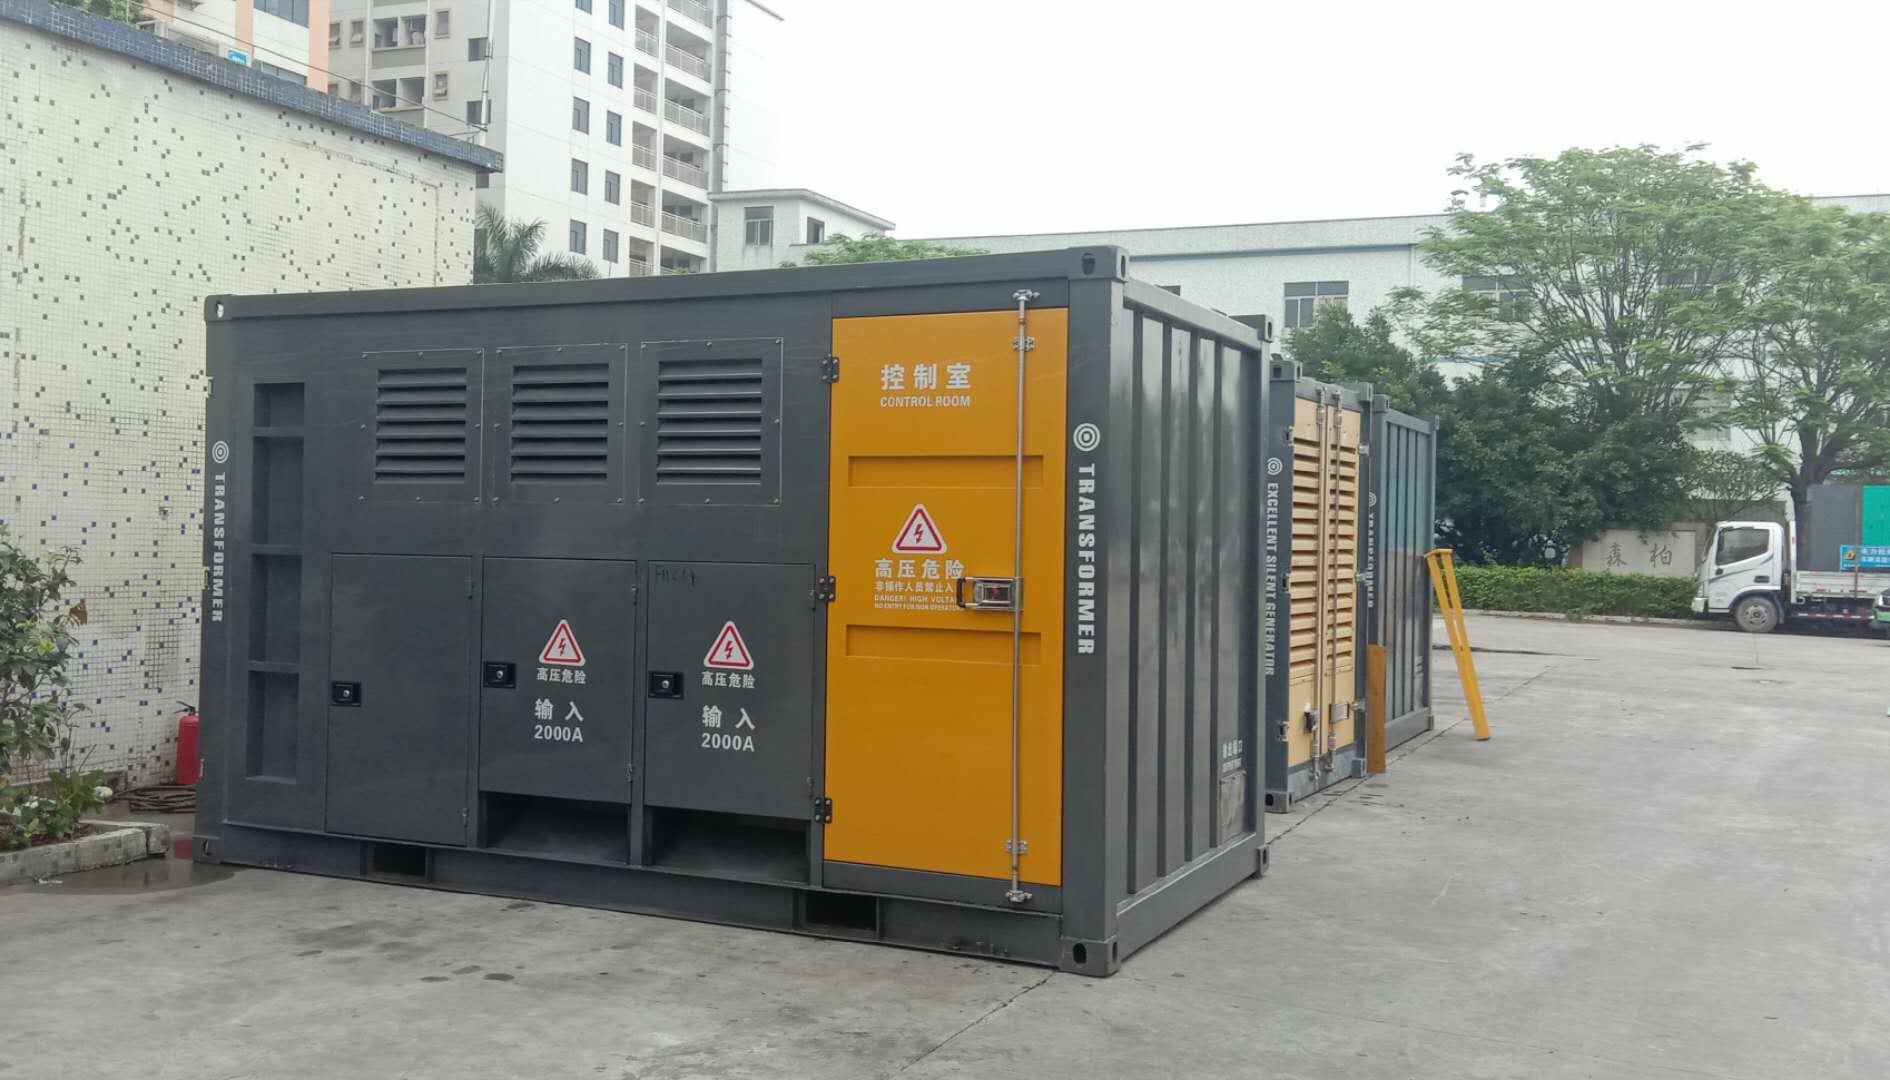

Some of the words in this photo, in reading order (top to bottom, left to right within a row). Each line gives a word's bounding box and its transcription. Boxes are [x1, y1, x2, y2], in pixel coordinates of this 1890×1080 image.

[881, 362, 971, 390] 控制室
[880, 395, 934, 408] CONTROL
[935, 395, 970, 407] ROOM
[1266, 483, 1279, 552] EXCELLENT
[212, 472, 225, 622] TRANSFORMER
[1078, 463, 1095, 654] TRANSFORMER
[874, 558, 964, 579] 高压危险
[1265, 555, 1278, 599] SILENT
[1263, 602, 1277, 676] GENERATOR
[536, 667, 587, 684] 高压危险
[701, 671, 755, 688] 高压危险
[534, 698, 584, 721] 输入
[702, 705, 755, 730] 输入
[534, 724, 583, 742] 2000A
[702, 732, 754, 752] 2000A
